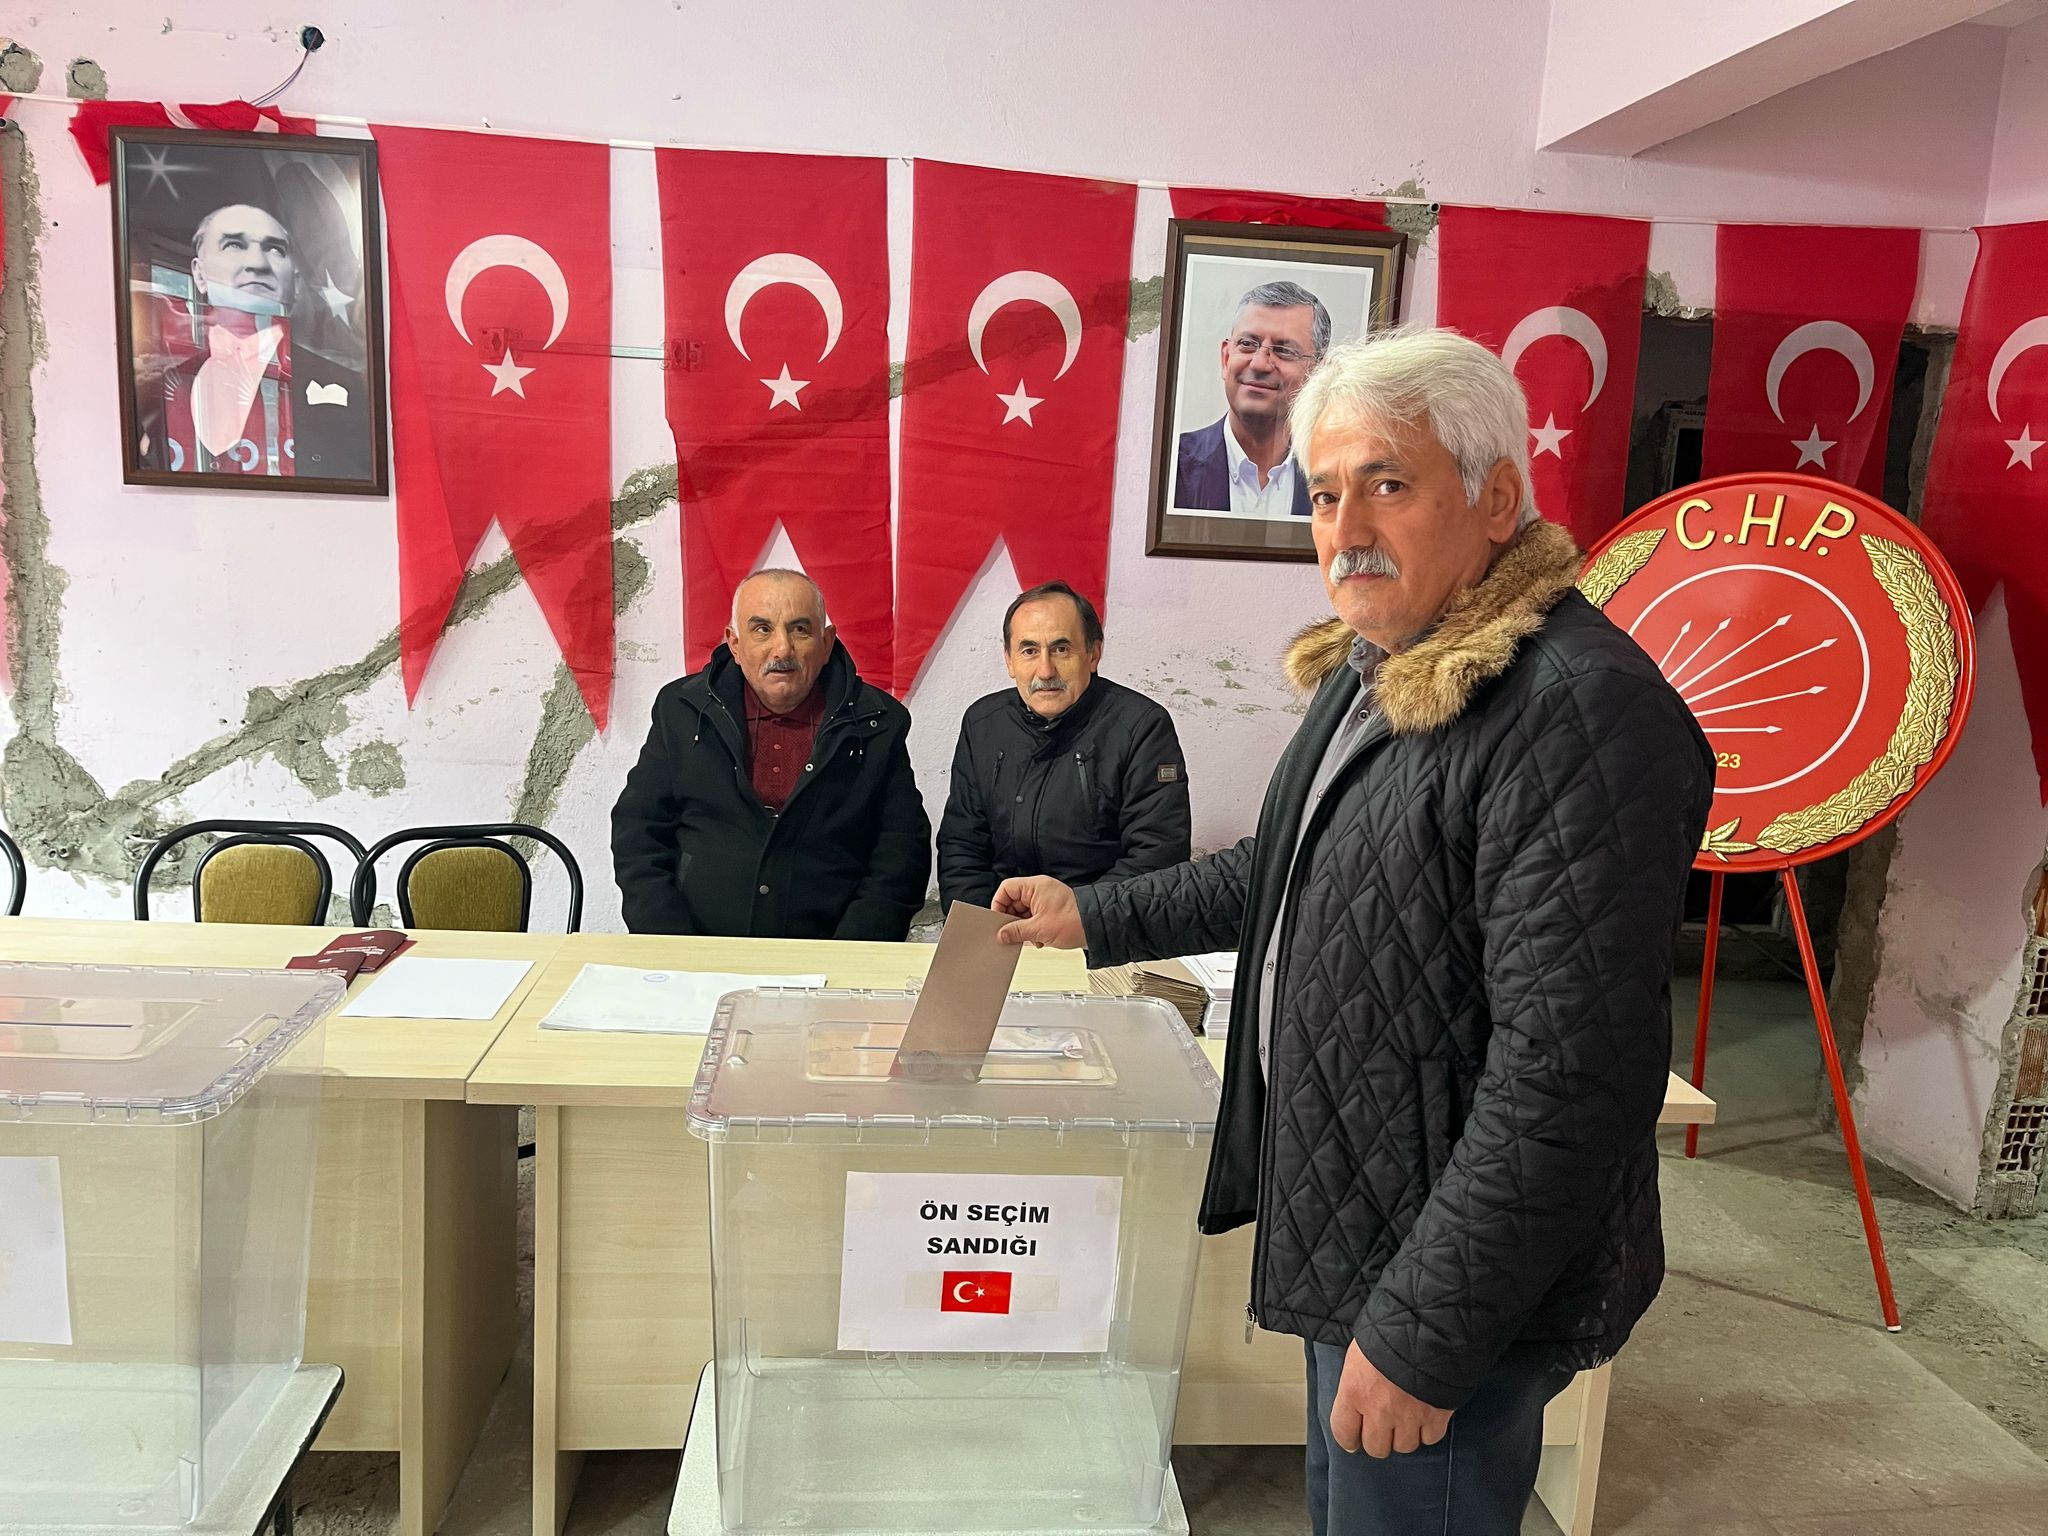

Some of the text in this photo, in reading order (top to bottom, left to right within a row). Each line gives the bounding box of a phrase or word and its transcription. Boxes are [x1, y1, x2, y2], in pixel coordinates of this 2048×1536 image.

[1674, 493, 1856, 557] C.H.P.
[1713, 751, 1742, 769] 23
[919, 1200, 1050, 1227] ÖN SEÇİM
[926, 1234, 1037, 1257] SANDIĞI
